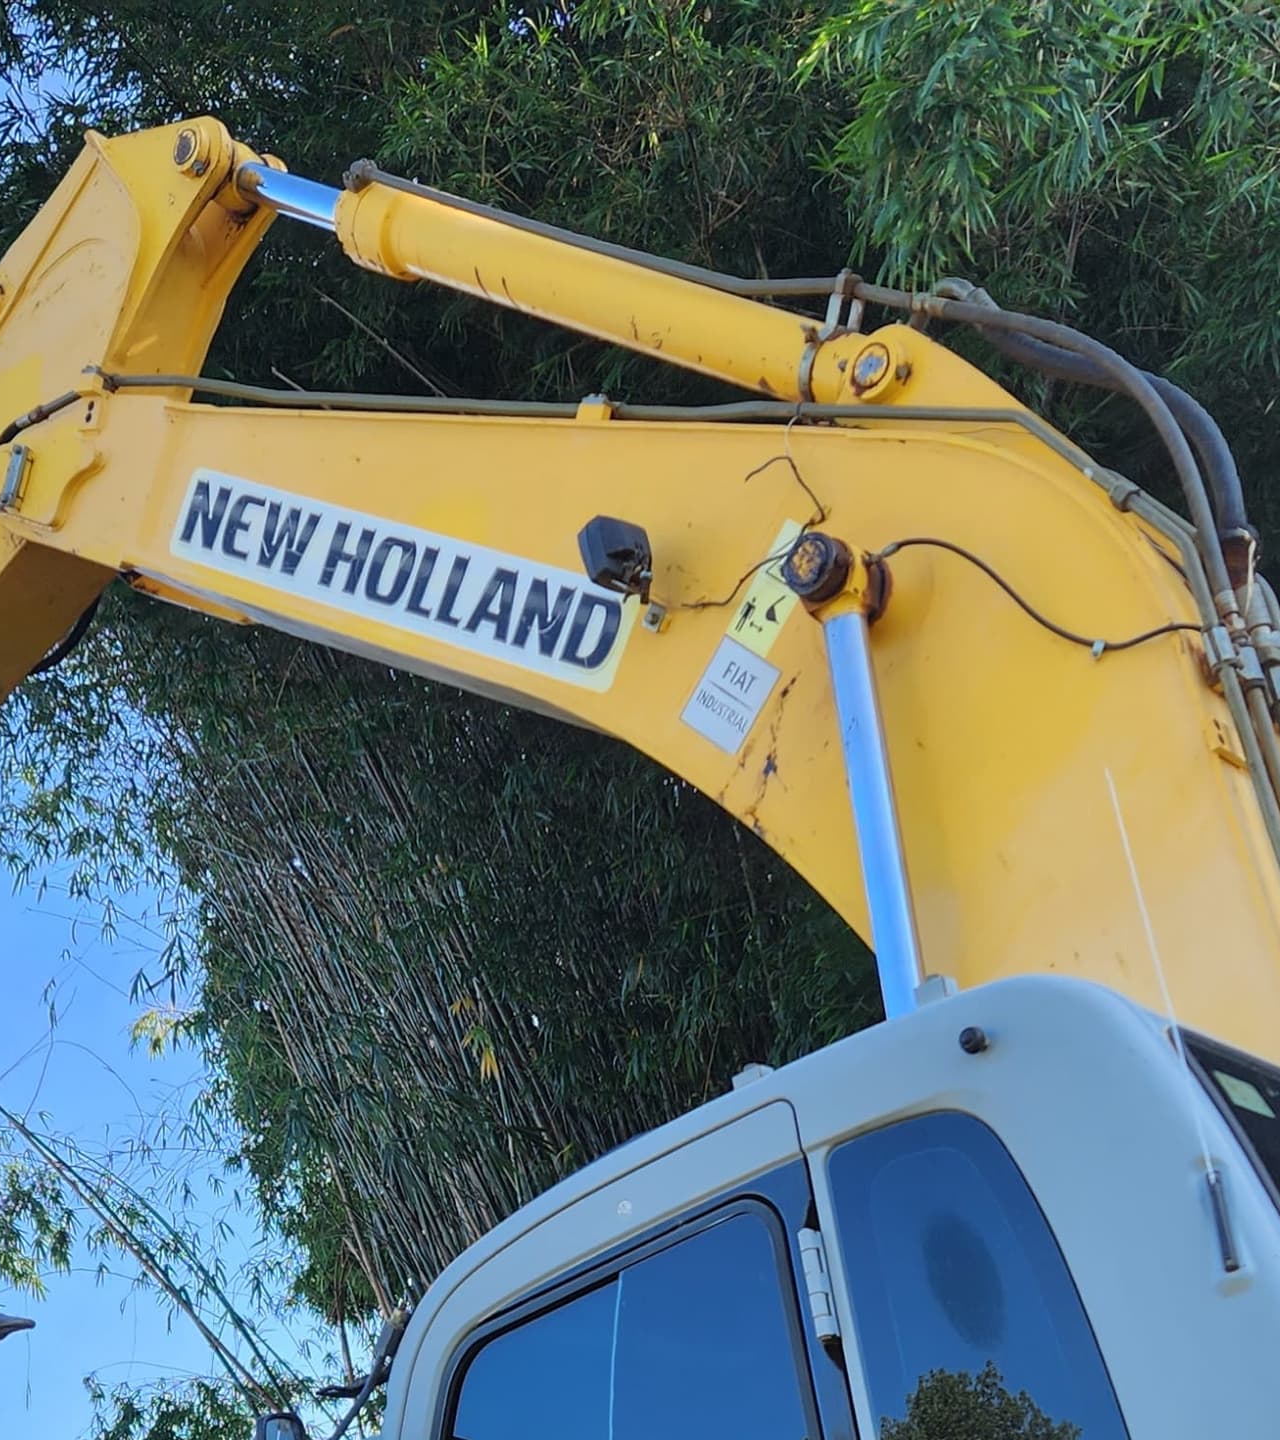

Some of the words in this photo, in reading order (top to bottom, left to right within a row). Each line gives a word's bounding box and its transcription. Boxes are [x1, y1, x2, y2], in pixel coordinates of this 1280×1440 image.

[179, 478, 322, 577] NEW
[320, 519, 623, 670] HOLLAND
[721, 661, 758, 695] FIAT
[695, 688, 748, 734] INDUSTRIAL
